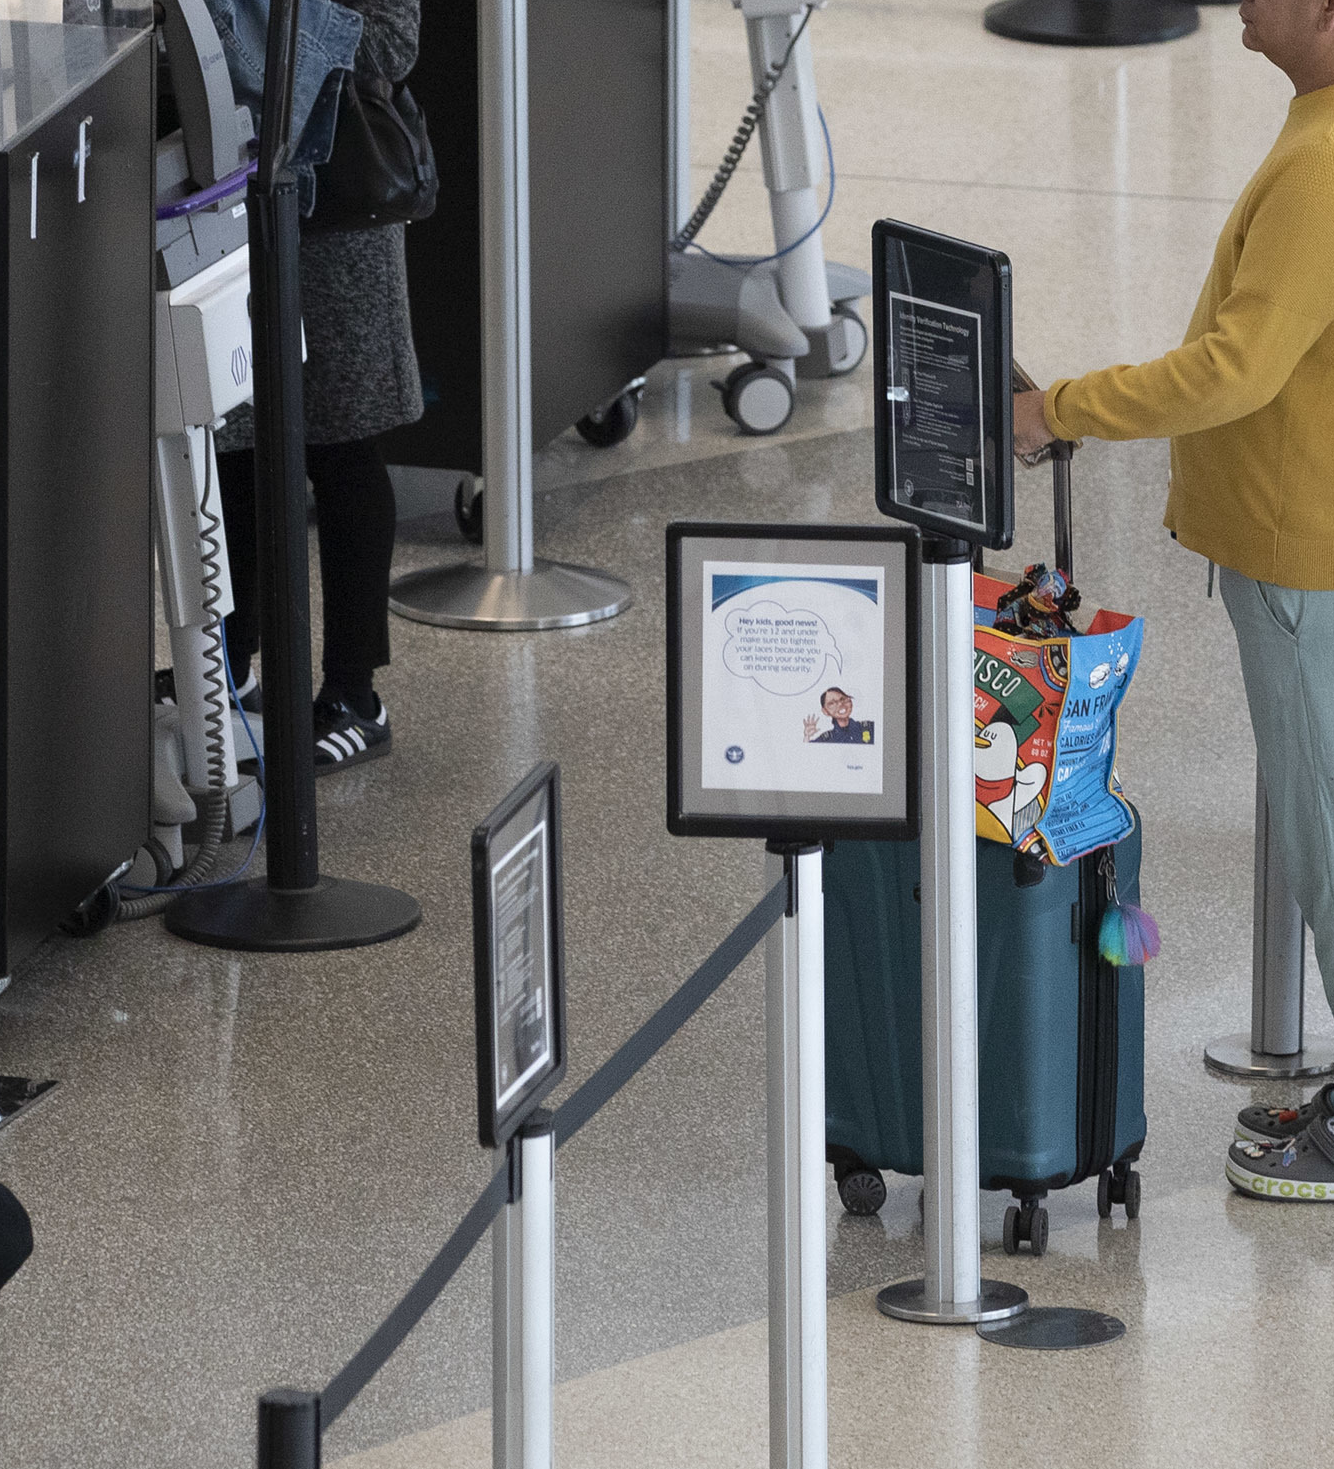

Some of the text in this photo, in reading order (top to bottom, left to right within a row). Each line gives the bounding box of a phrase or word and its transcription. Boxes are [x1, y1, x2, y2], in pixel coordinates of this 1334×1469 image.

[739, 618, 754, 626] Hey
[756, 618, 773, 626] kids,
[755, 655, 773, 663] keep
[755, 664, 779, 672] during
[974, 652, 1021, 697] ISCO
[1251, 1176, 1327, 1199] crocs
